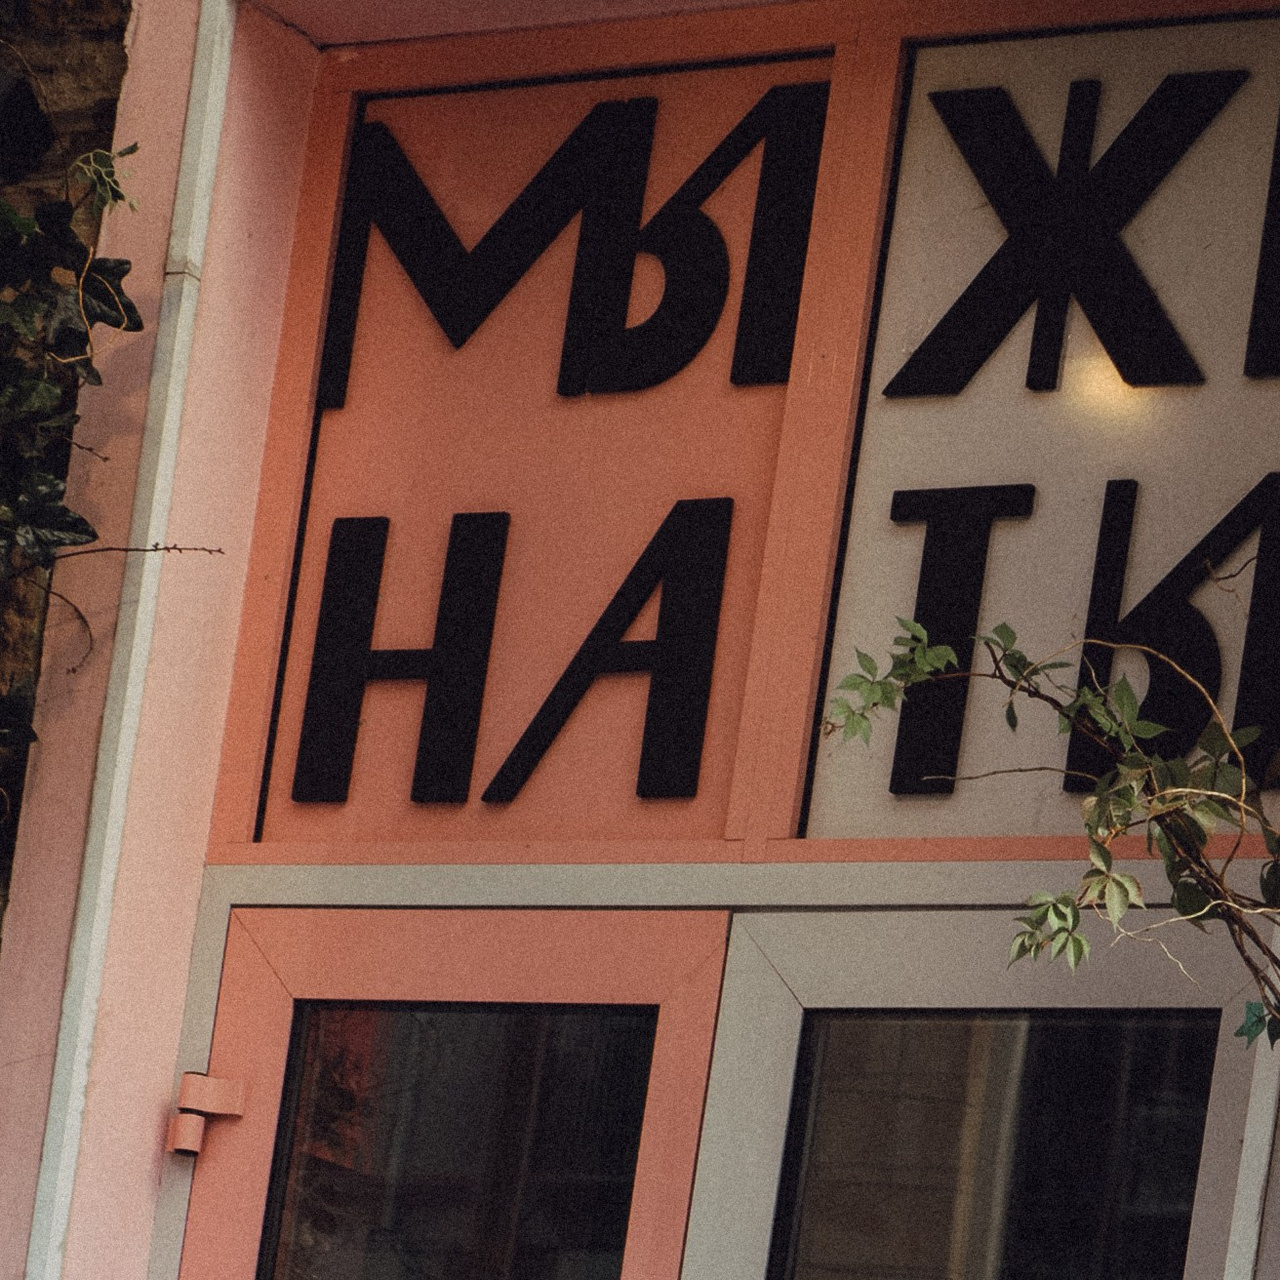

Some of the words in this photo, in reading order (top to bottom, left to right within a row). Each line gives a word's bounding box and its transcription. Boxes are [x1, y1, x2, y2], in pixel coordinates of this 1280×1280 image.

[322, 80, 832, 410] МЫ
[881, 69, 1280, 398] Ж
[291, 497, 734, 804] НА
[889, 471, 1280, 796] ТЫ
